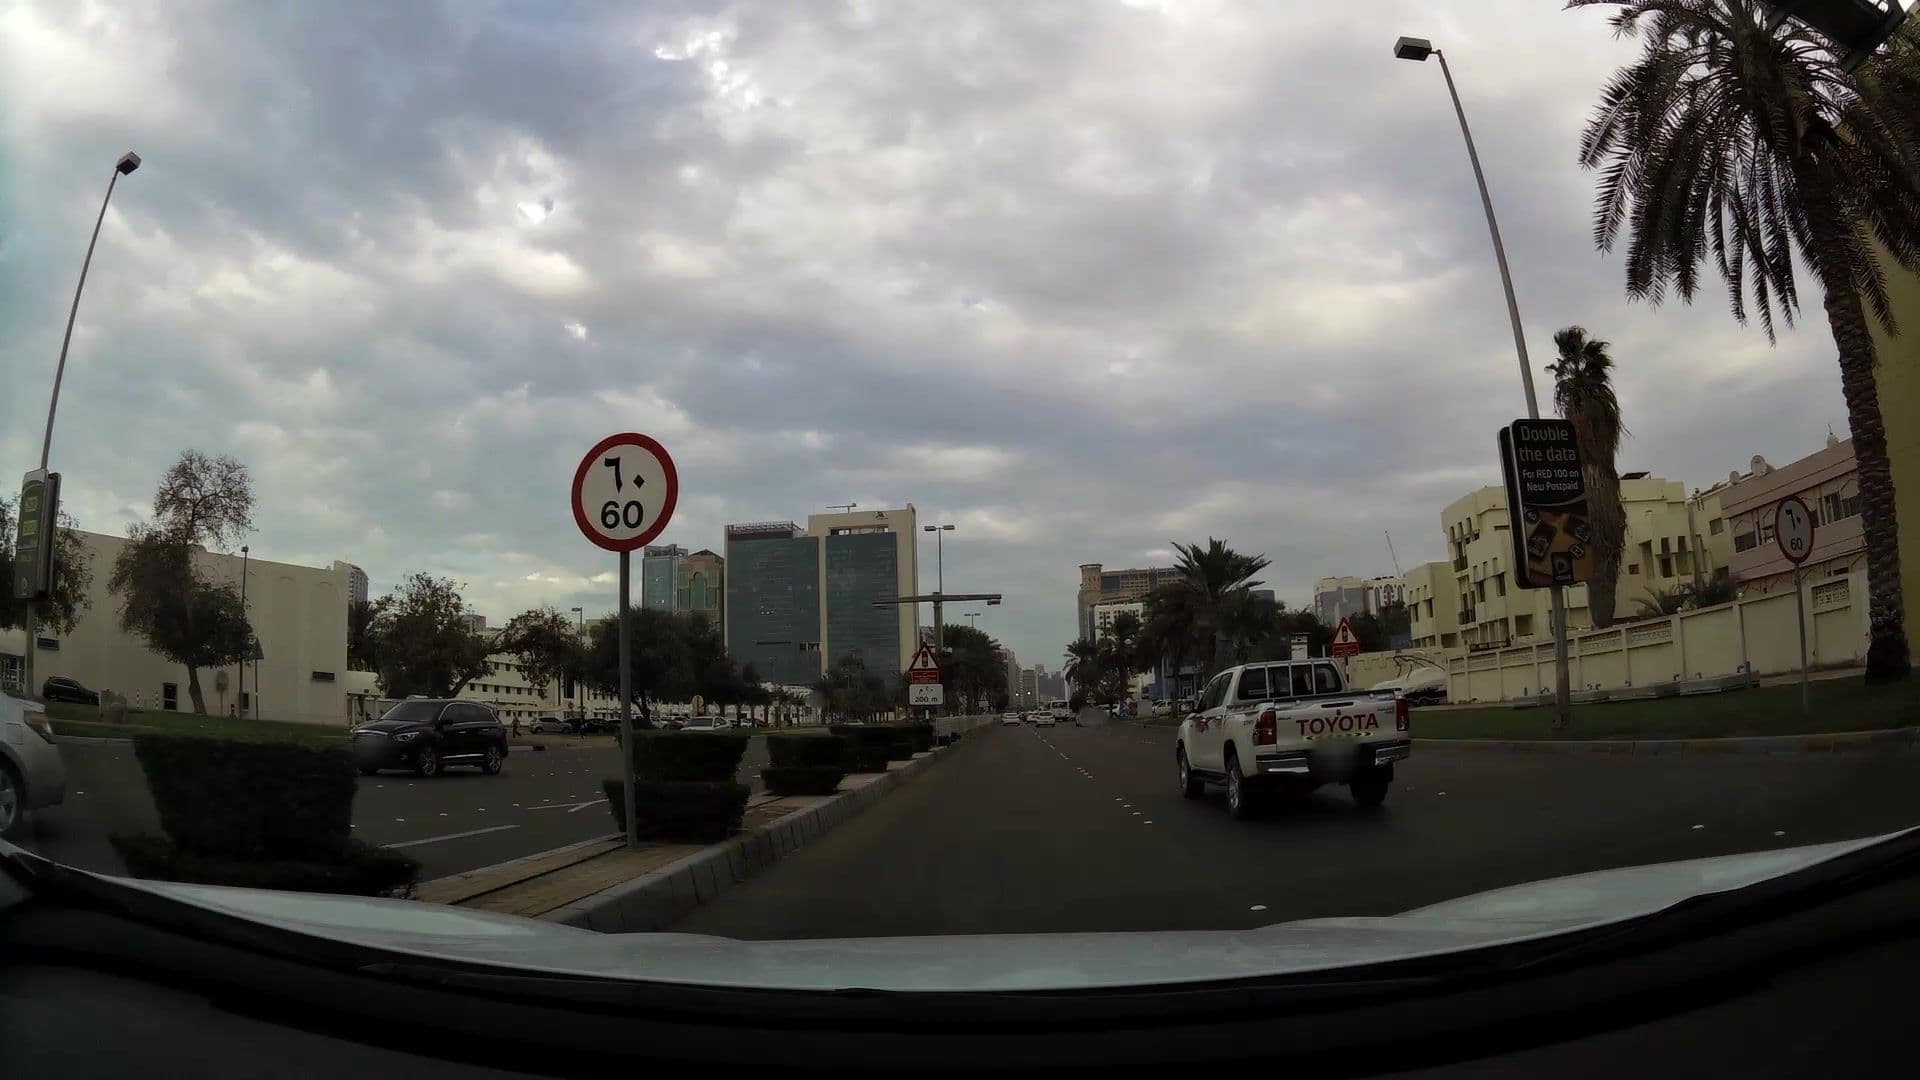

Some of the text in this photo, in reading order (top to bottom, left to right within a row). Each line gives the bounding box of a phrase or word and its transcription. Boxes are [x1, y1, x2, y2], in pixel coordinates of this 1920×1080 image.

[1520, 425, 1569, 441] Double
[1519, 445, 1577, 462] the data
[604, 456, 645, 493] ٦٠
[1522, 469, 1535, 479] For
[1536, 469, 1552, 479] RED
[1553, 468, 1568, 478] 100
[1526, 481, 1579, 491] New Postpaid
[601, 500, 644, 529] 60
[1791, 537, 1803, 551] 60
[1296, 713, 1379, 736] TOYOTA
